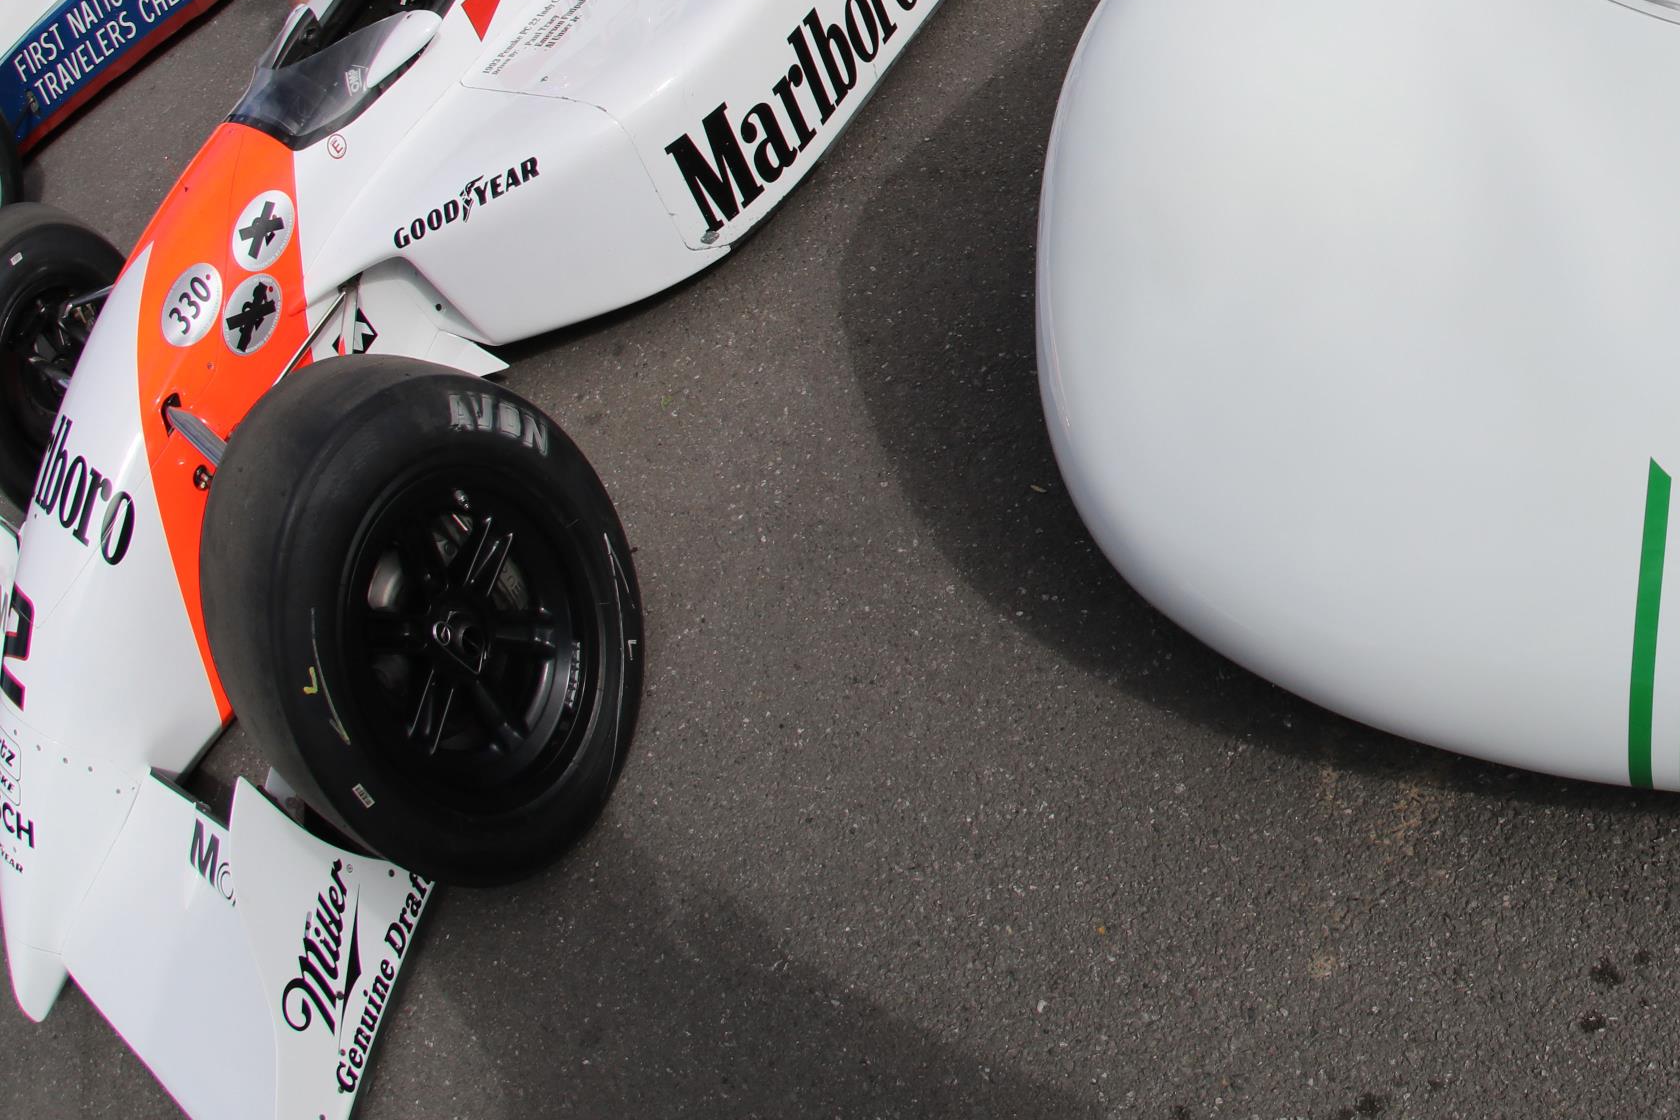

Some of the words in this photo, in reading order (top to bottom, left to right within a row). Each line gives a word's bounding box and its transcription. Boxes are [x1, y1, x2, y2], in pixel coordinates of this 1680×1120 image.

[14, 22, 64, 82] FIRST
[34, 10, 137, 106] TRAVELERS
[394, 156, 541, 249] GOODYEAR
[168, 274, 207, 335] 330
[447, 392, 550, 457] AVON
[34, 413, 136, 566] lboro
[281, 858, 348, 1038] Miller
[336, 957, 395, 1094] Genuine
[385, 871, 434, 959] Draft
